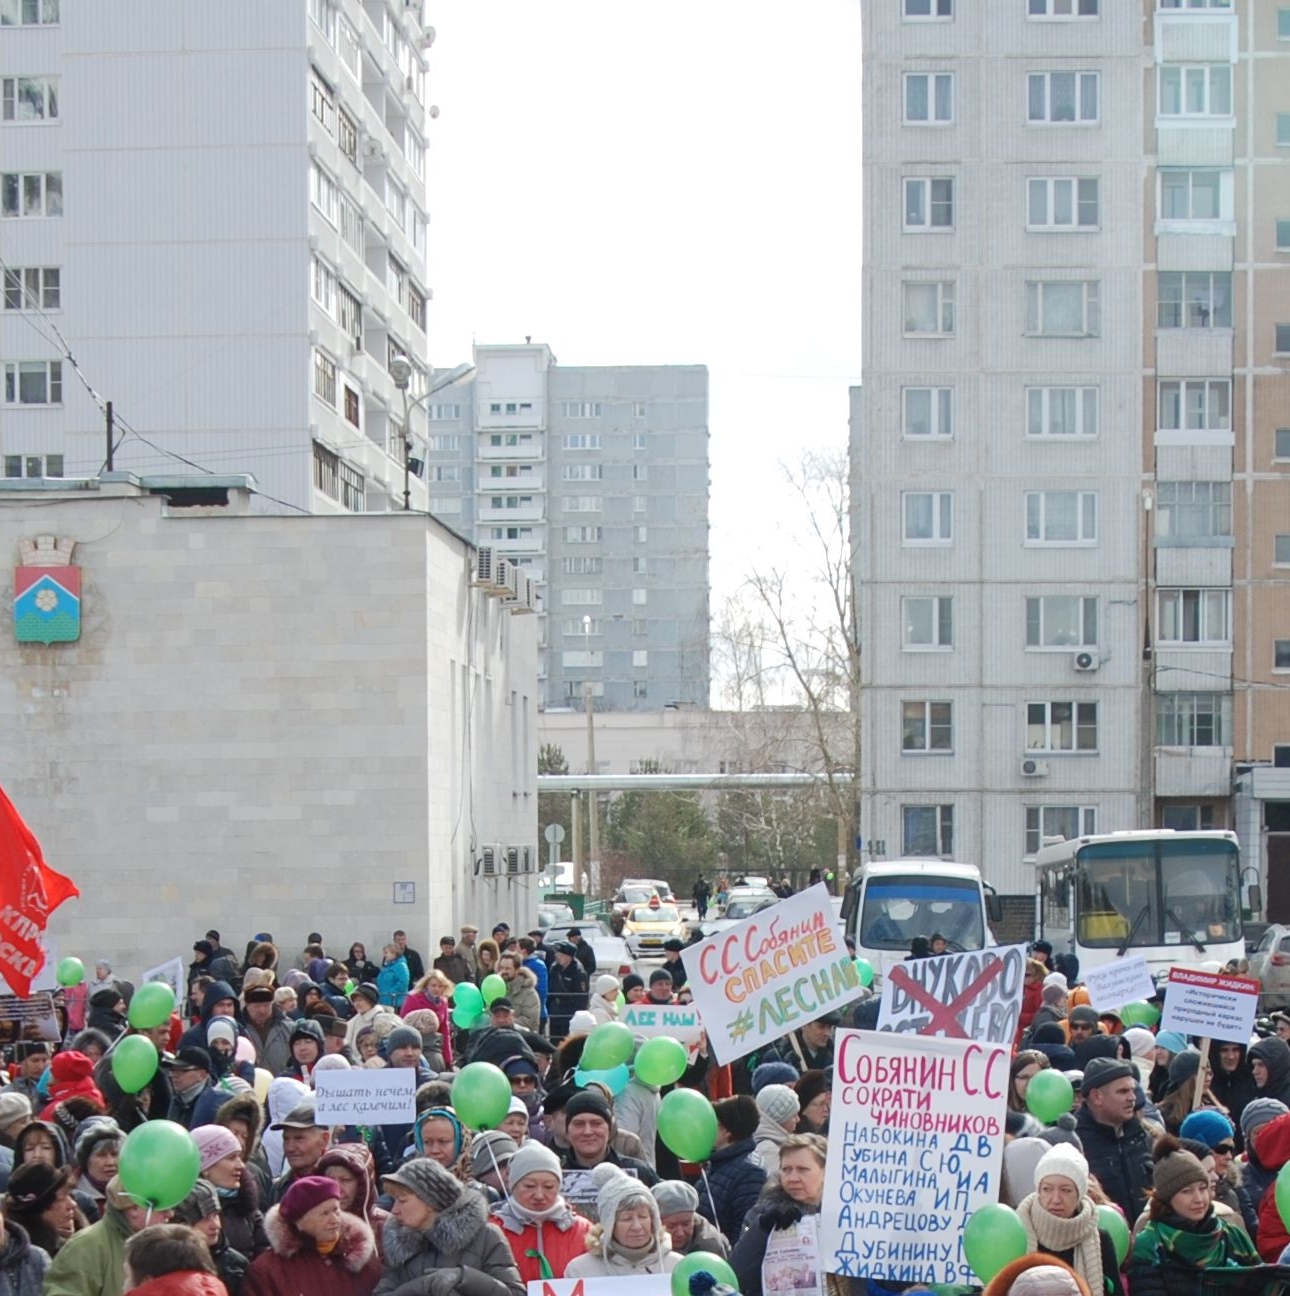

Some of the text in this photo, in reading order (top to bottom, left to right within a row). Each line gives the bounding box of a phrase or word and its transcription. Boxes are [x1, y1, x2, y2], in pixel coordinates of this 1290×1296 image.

[723, 927, 837, 1004] СПАСИТЕ
[315, 1086, 372, 1099] Дышать
[842, 1085, 932, 1112] СОКРАТИ
[328, 1103, 349, 1112] лес
[352, 1099, 413, 1114] калечим!
[870, 1108, 1001, 1137] ЧИНОВНИКОВ
